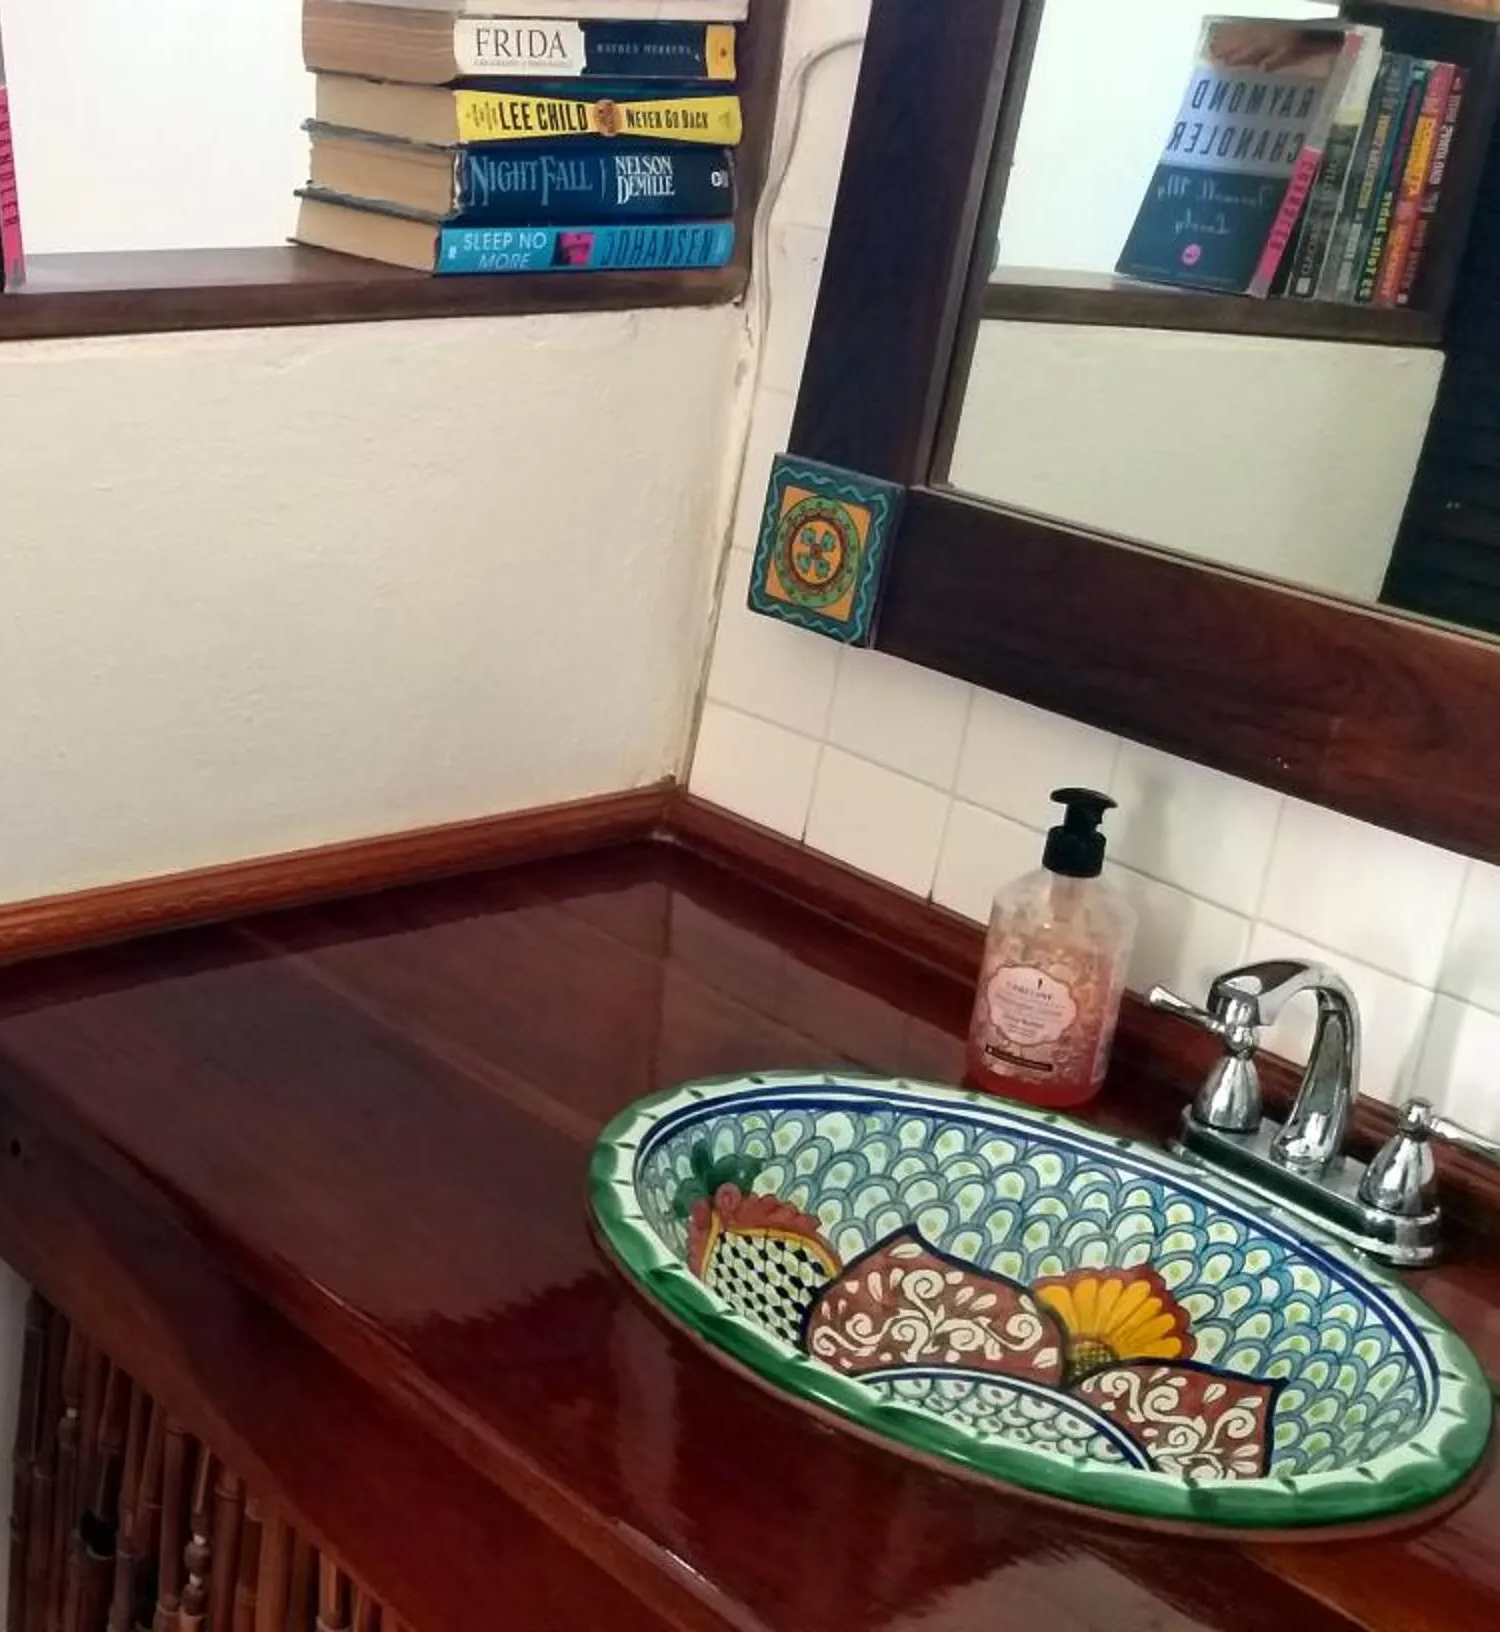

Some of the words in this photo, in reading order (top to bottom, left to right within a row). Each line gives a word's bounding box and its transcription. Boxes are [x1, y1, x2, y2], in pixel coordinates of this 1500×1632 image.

[475, 27, 568, 58] FRIDA
[498, 101, 533, 131] LEE
[536, 102, 589, 131] CHILD
[626, 108, 662, 129] NEVER
[665, 108, 679, 129] GO
[681, 109, 709, 129] BACK
[614, 155, 673, 175] NELSON
[616, 175, 675, 205] DEMILLE
[463, 233, 515, 250] SLEEP
[518, 231, 548, 250] NO
[600, 228, 714, 266] JOHANSEN
[478, 252, 531, 270] MORE
